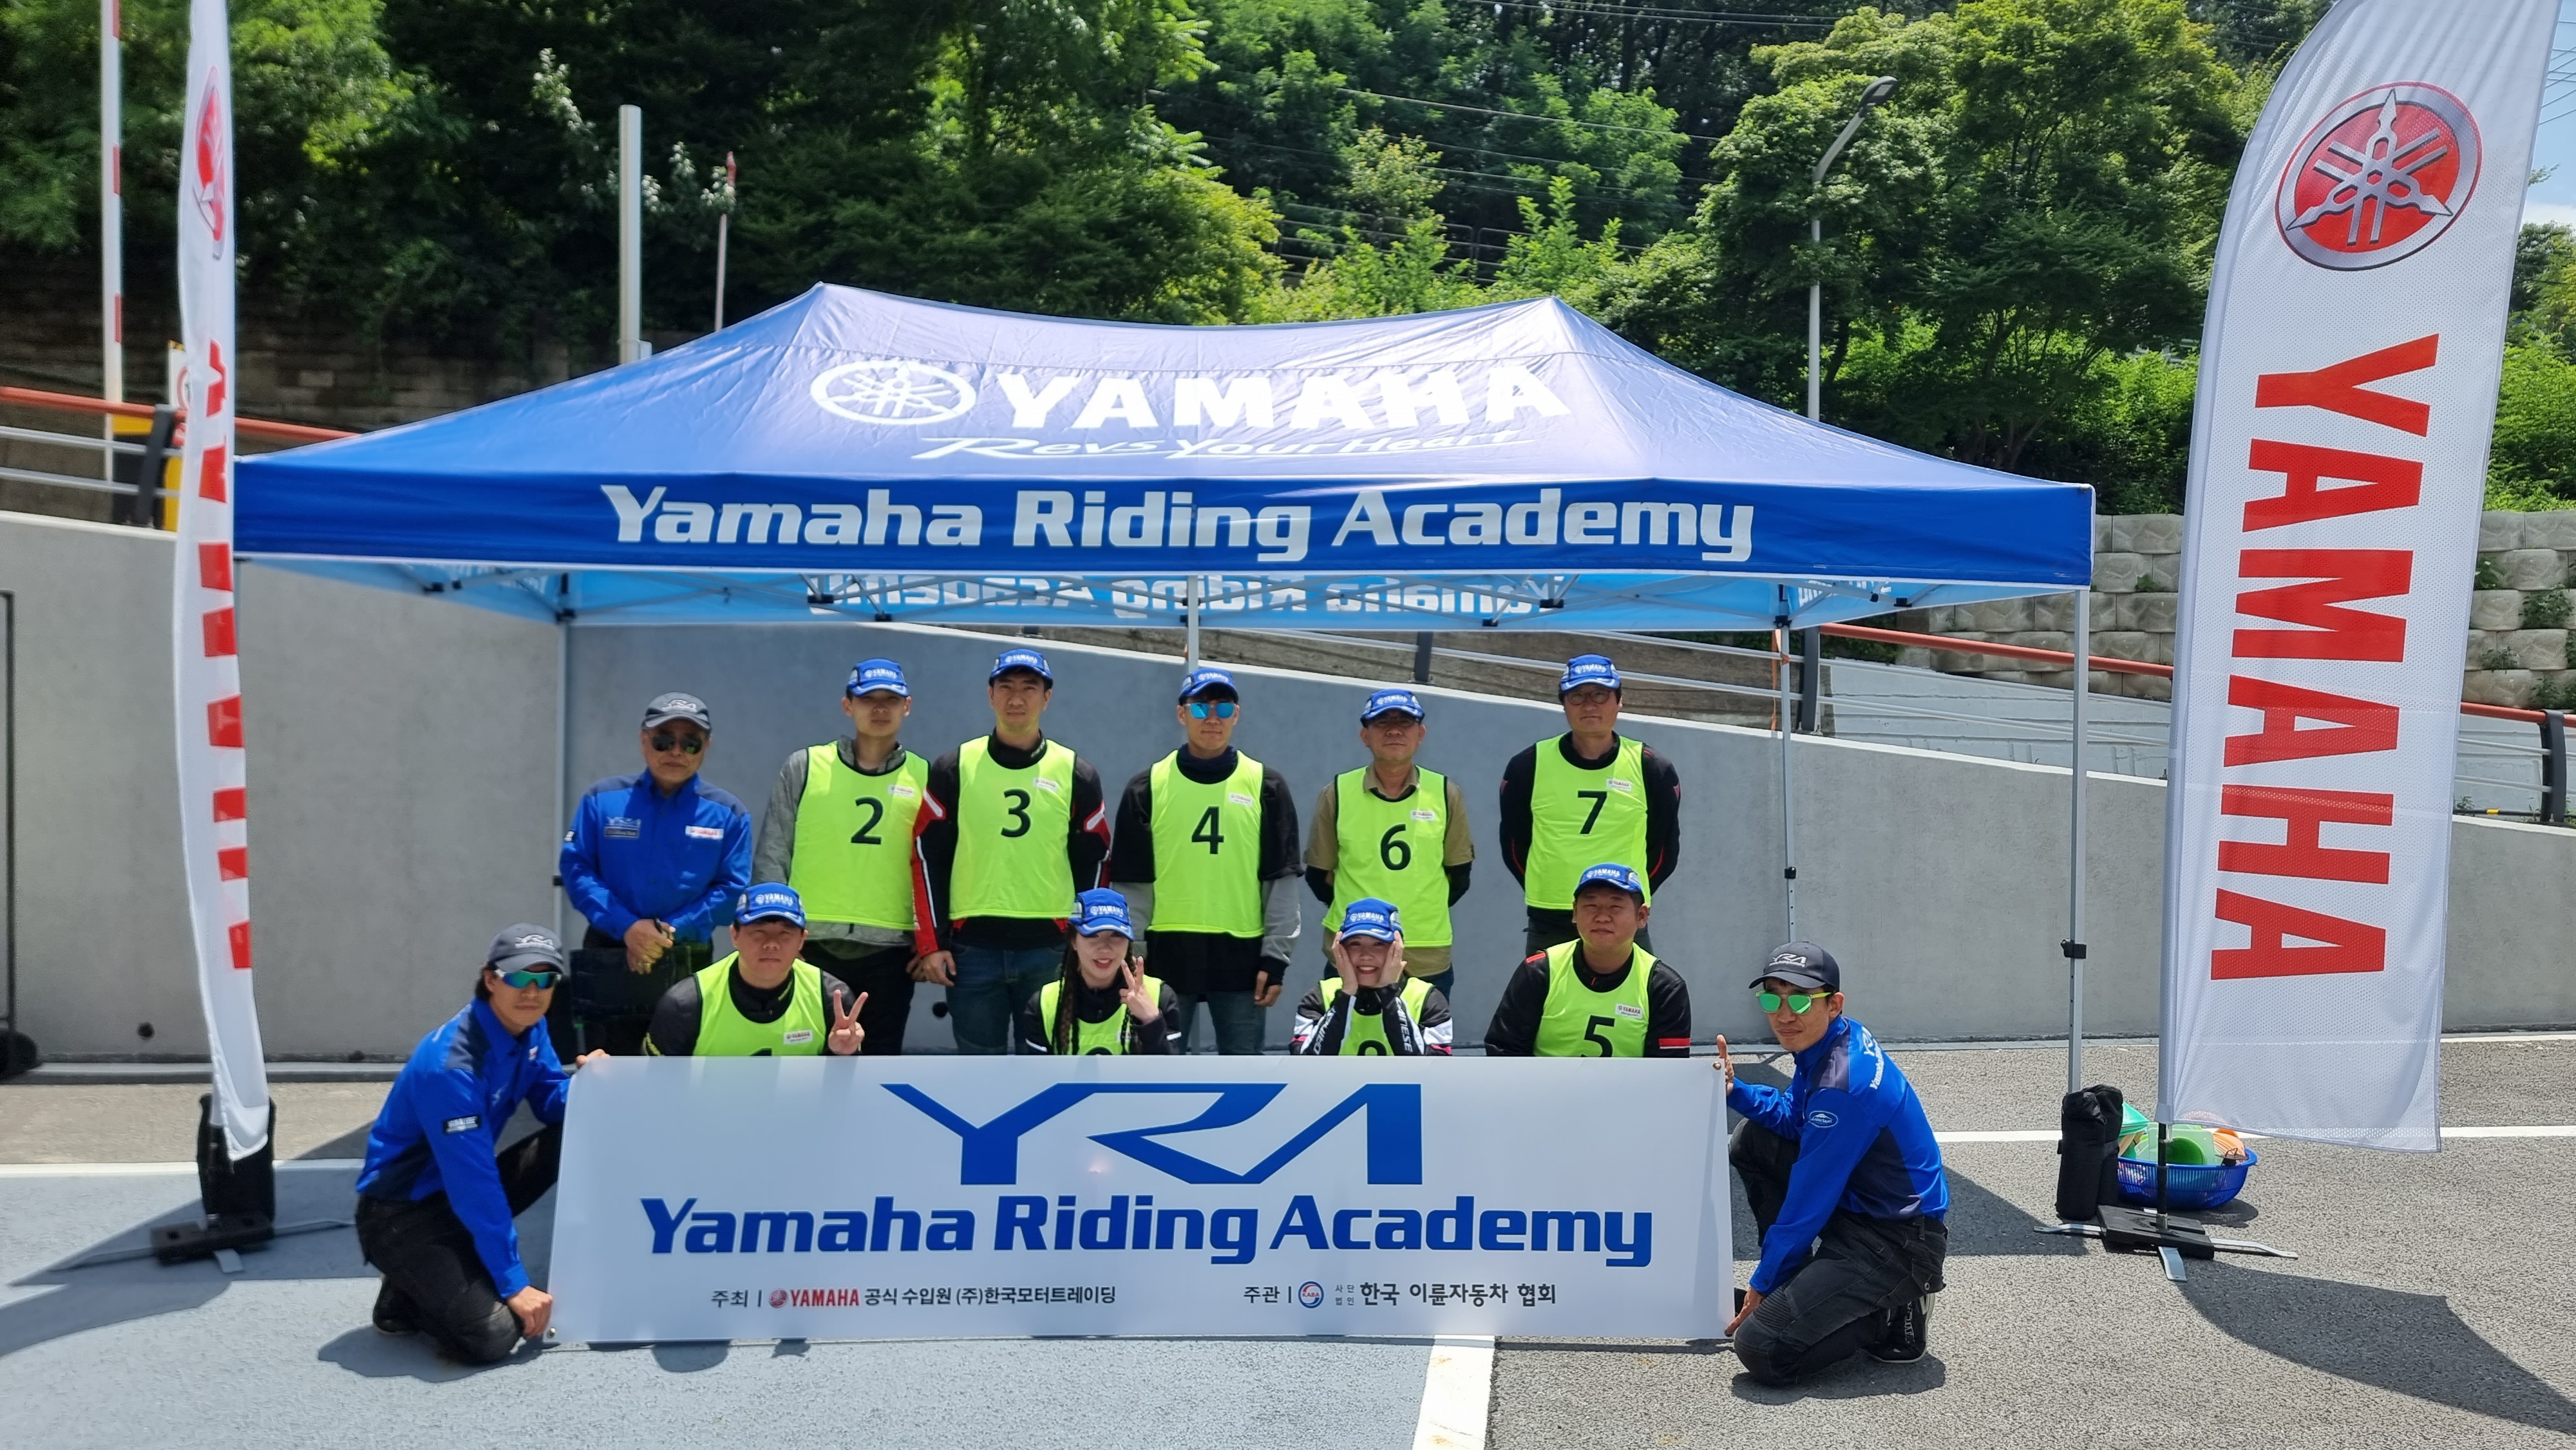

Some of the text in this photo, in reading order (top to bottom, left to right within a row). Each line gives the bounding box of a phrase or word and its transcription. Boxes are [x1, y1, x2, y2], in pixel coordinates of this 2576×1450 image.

[998, 364, 1572, 429] YAMAHA
[911, 428, 1524, 461] Revs Your Heart
[600, 484, 1754, 562] Yamaha Riding Academy
[2211, 333, 2439, 980] YAMAHA
[851, 797, 883, 844] 2
[1000, 789, 1032, 838] 3
[1191, 806, 1224, 854] 4
[1577, 791, 1607, 834] 7
[1380, 824, 1411, 871] 6
[764, 893, 793, 904] YAMAHA
[1098, 905, 1123, 915] YAMAHA
[1357, 912, 1384, 921] YAMAHA
[1622, 1006, 1640, 1014] YAMAHA
[1581, 1015, 1615, 1057] 5
[880, 1082, 1423, 1185] YRA
[639, 1194, 1653, 1267] Yamaha Riding Academy
[711, 1286, 1117, 1308] 주최 YAMAHA 공식 수입원 (주)한국모터트레이딩
[1244, 1285, 1281, 1304] 주관
[1360, 1282, 1557, 1308] 한국 이륜자동차 협회
